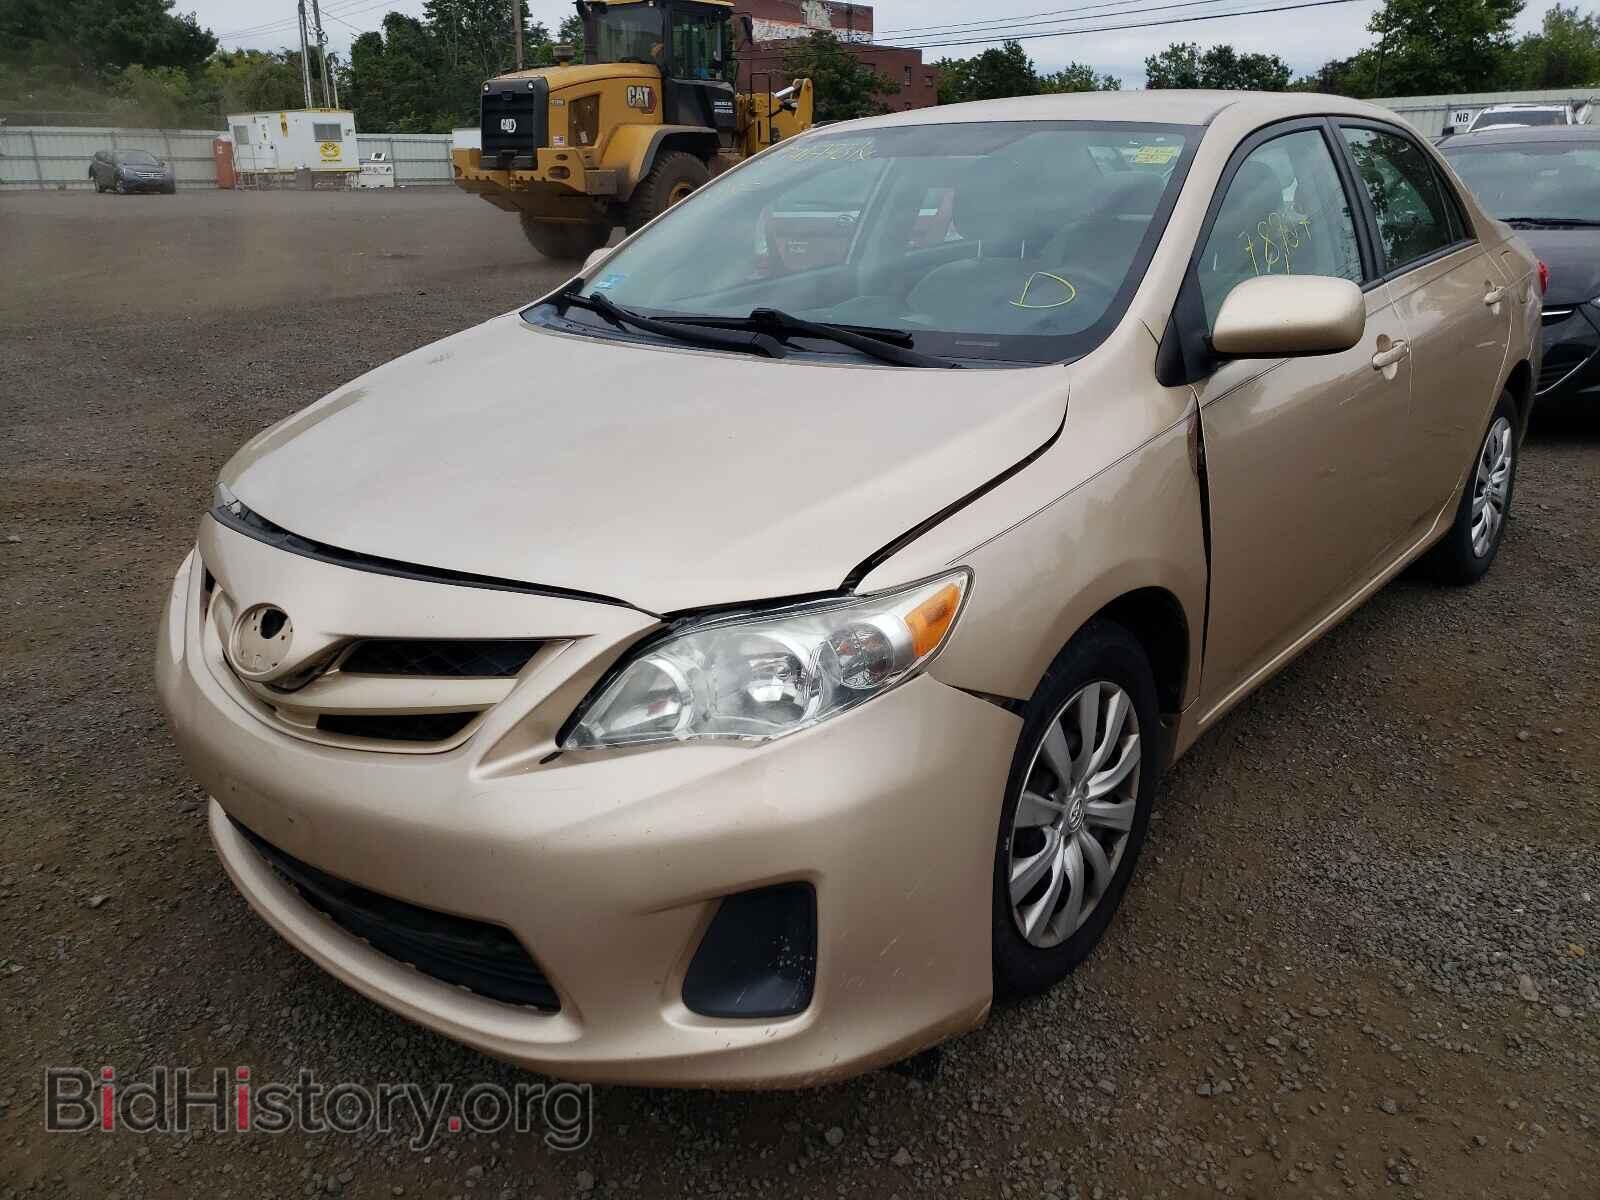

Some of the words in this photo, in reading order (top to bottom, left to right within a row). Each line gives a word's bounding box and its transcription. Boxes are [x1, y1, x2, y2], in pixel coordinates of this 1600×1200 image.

[627, 86, 650, 107] CAT
[500, 118, 515, 131] CAT
[1455, 112, 1469, 123] NB
[1009, 271, 1076, 308] D
